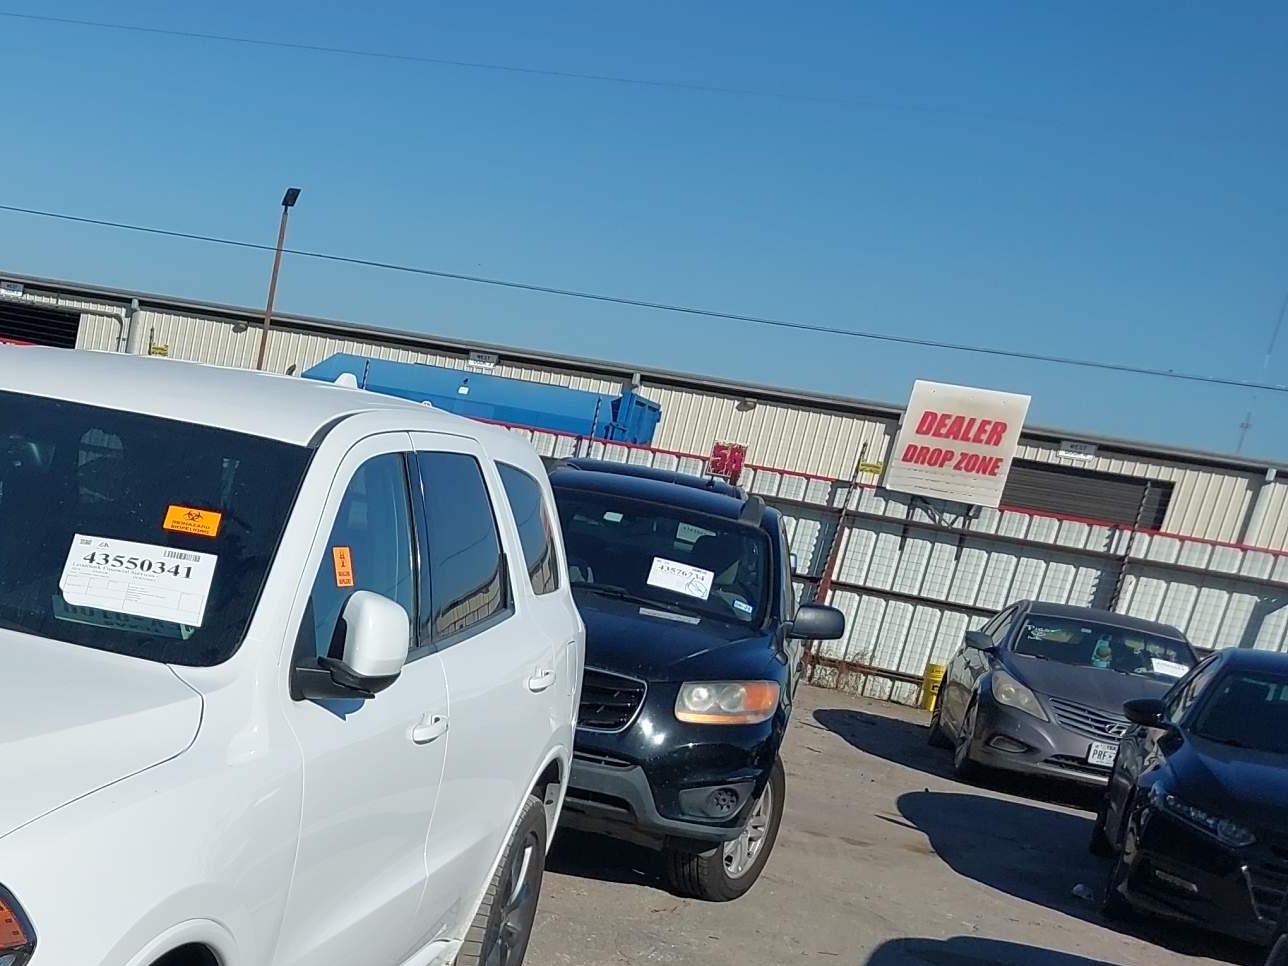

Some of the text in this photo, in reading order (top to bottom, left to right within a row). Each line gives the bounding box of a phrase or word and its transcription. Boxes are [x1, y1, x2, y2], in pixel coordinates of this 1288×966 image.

[915, 410, 1007, 447] DEALER
[901, 443, 955, 469] DROP
[952, 451, 1004, 477] ZONE
[83, 551, 193, 579] 43550341
